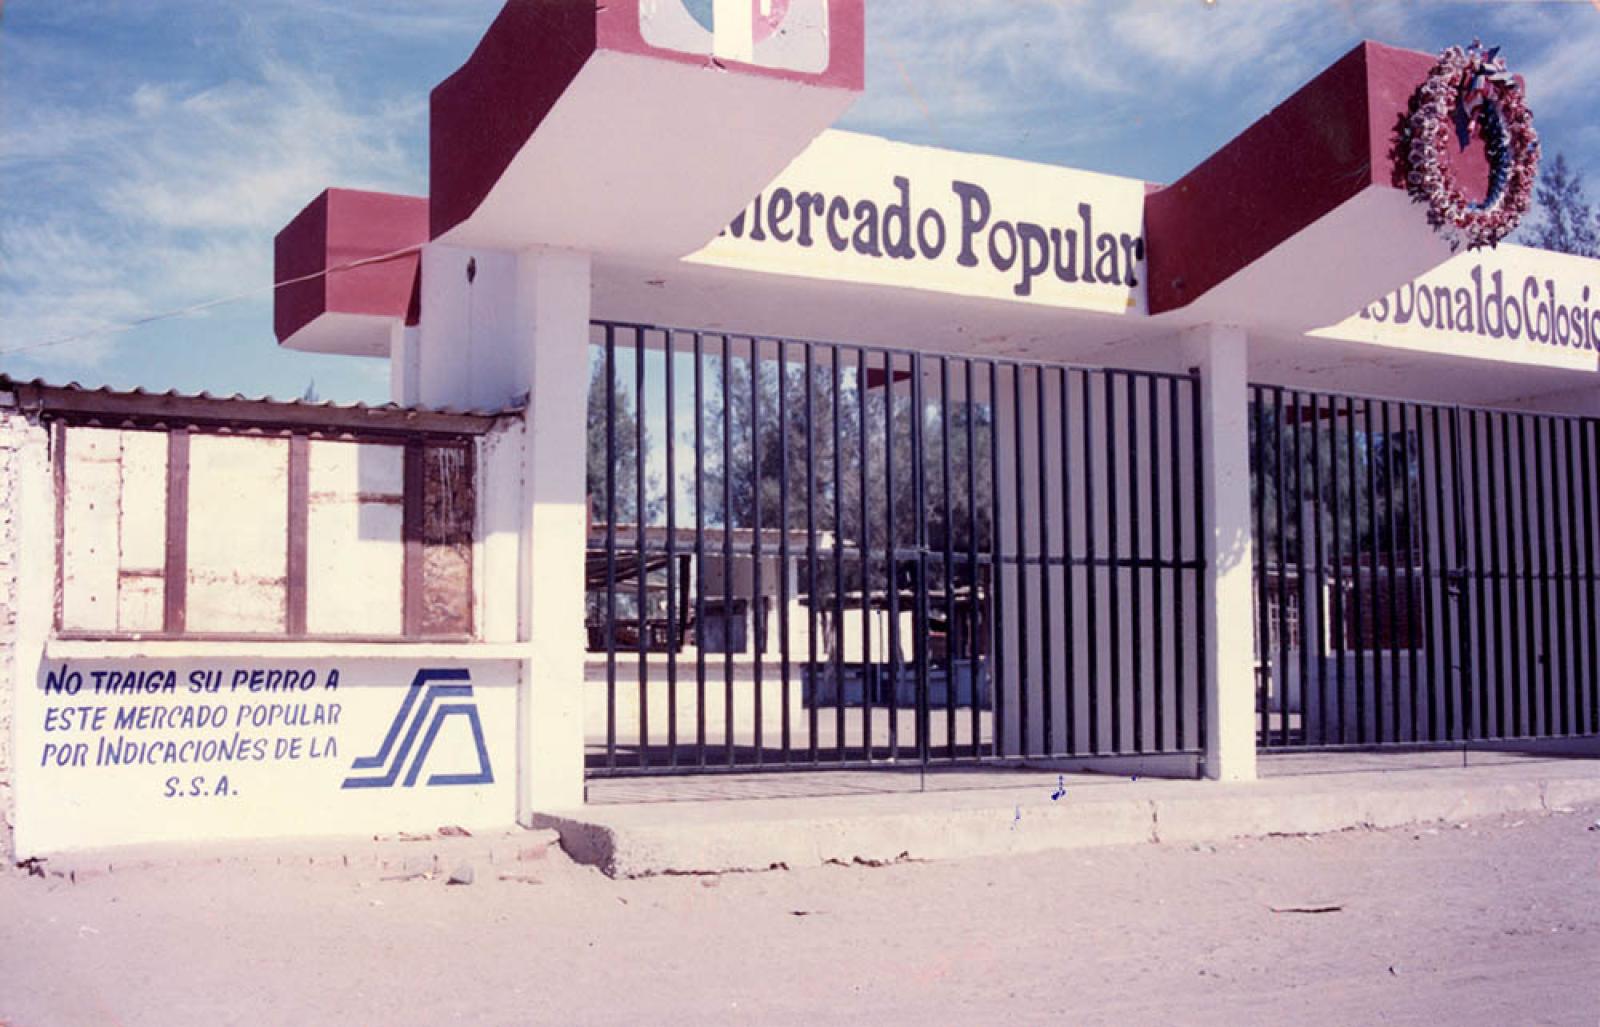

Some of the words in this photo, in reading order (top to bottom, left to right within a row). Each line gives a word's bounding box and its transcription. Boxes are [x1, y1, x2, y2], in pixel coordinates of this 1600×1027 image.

[952, 180, 1143, 296] Popular
[1394, 264, 1521, 340] Donaldo
[45, 663, 83, 695] NO
[90, 670, 177, 695] TRAIGA
[188, 669, 222, 694] SU
[231, 668, 316, 692] PERRO
[324, 668, 340, 691] A
[44, 706, 108, 732] ESTE
[113, 704, 228, 730] MERCADO
[236, 703, 342, 727] POPULAR
[41, 743, 89, 767] POR
[96, 731, 268, 766] INDICACIONES
[274, 737, 302, 760] DE
[309, 736, 338, 759] LA
